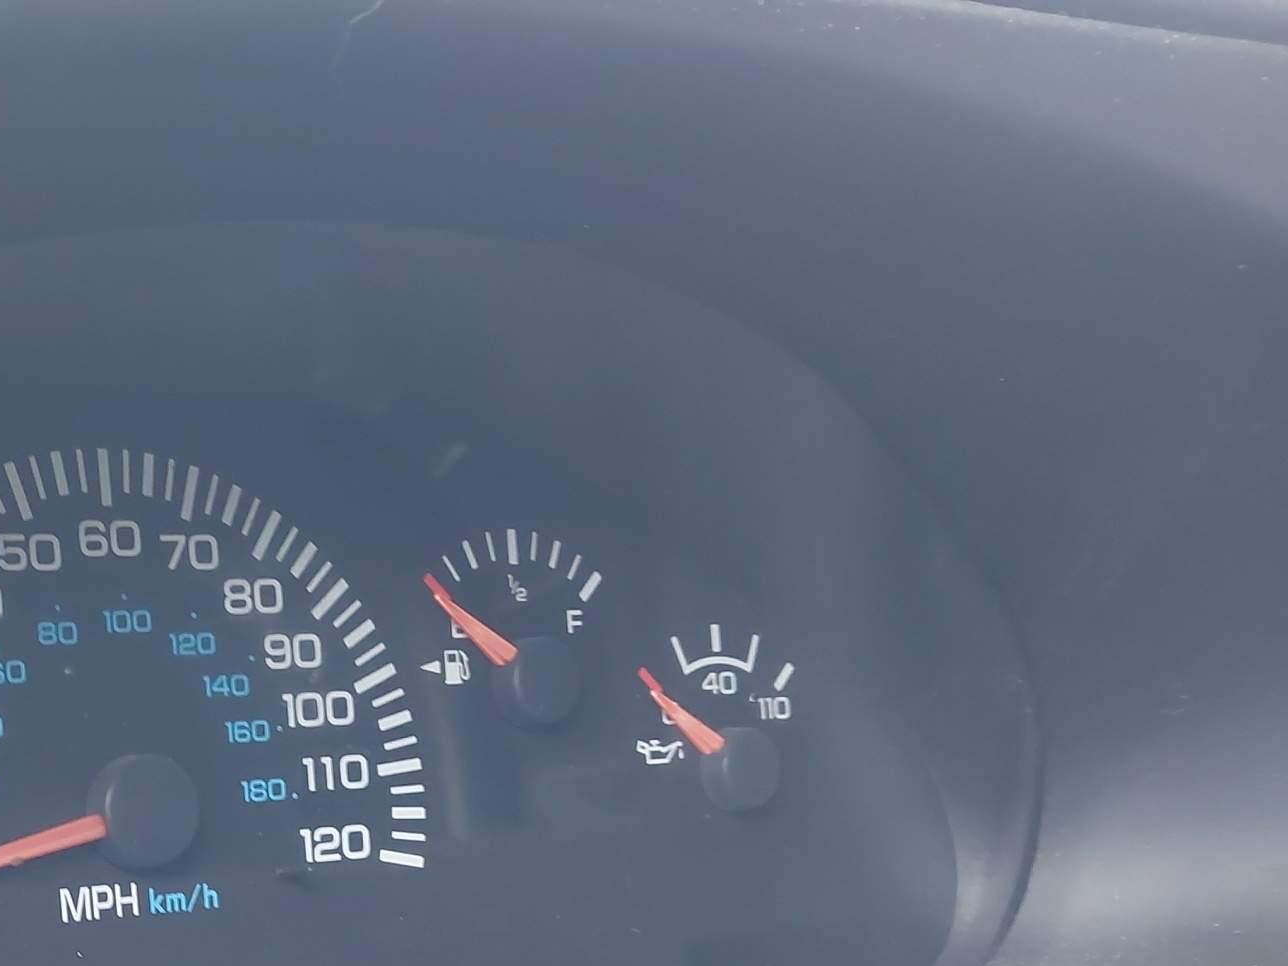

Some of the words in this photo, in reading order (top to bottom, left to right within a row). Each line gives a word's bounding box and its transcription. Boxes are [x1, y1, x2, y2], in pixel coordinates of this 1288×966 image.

[79, 521, 140, 557] 60
[160, 534, 218, 571] 70
[224, 578, 282, 615] 80
[38, 621, 78, 645] 80
[103, 609, 151, 633] 100
[567, 610, 583, 633] F
[169, 632, 216, 656] 120
[264, 633, 321, 670] 90
[204, 674, 249, 697] 140
[702, 671, 737, 694] 40
[282, 690, 354, 727] 100
[758, 697, 791, 719] 110
[226, 720, 270, 743] 160
[302, 754, 369, 791] 110
[241, 778, 285, 801] 180
[300, 824, 370, 863] 120
[60, 883, 140, 922] MPH
[149, 884, 219, 913] km/h
